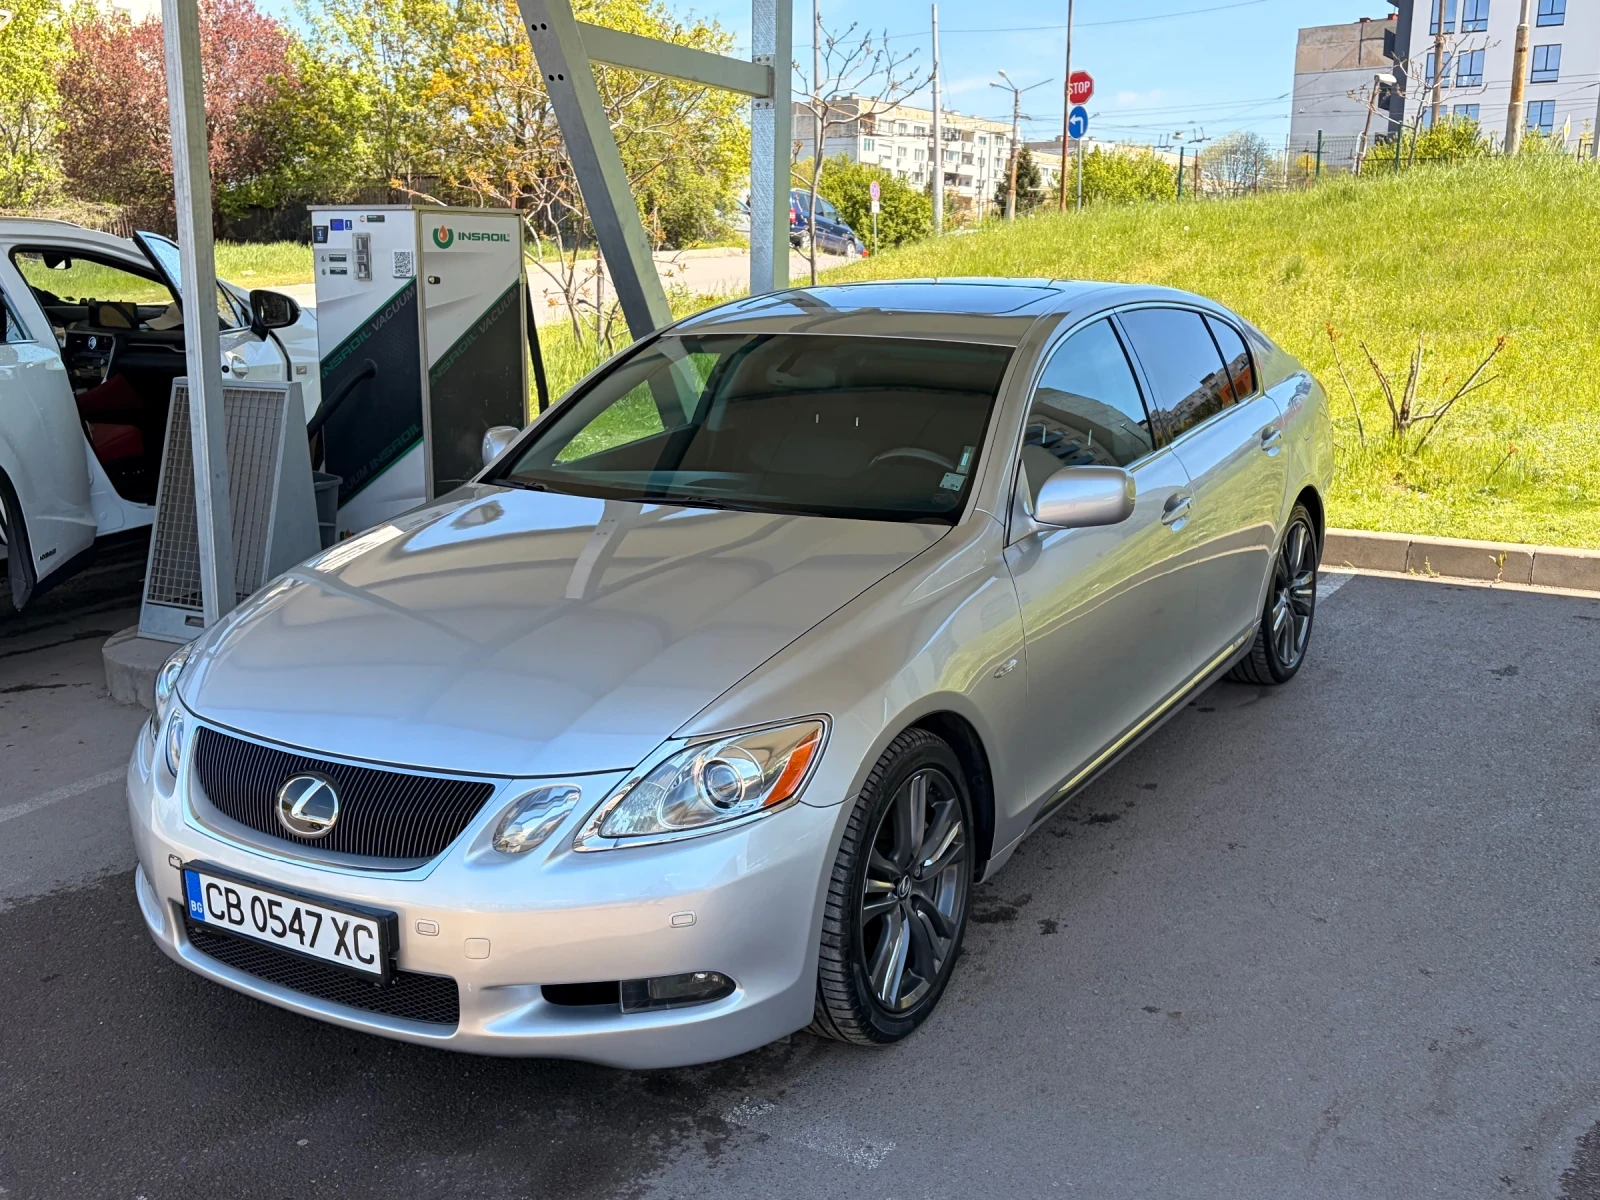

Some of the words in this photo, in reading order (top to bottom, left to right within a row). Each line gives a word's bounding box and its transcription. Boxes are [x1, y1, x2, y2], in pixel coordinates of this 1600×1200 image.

[1067, 82, 1090, 95] STOP
[371, 286, 416, 331] VACUUM
[479, 287, 517, 333] VACUUM
[190, 899, 203, 913] BG
[206, 882, 245, 926] CB
[250, 896, 322, 948] 0547
[331, 916, 375, 964] XC
